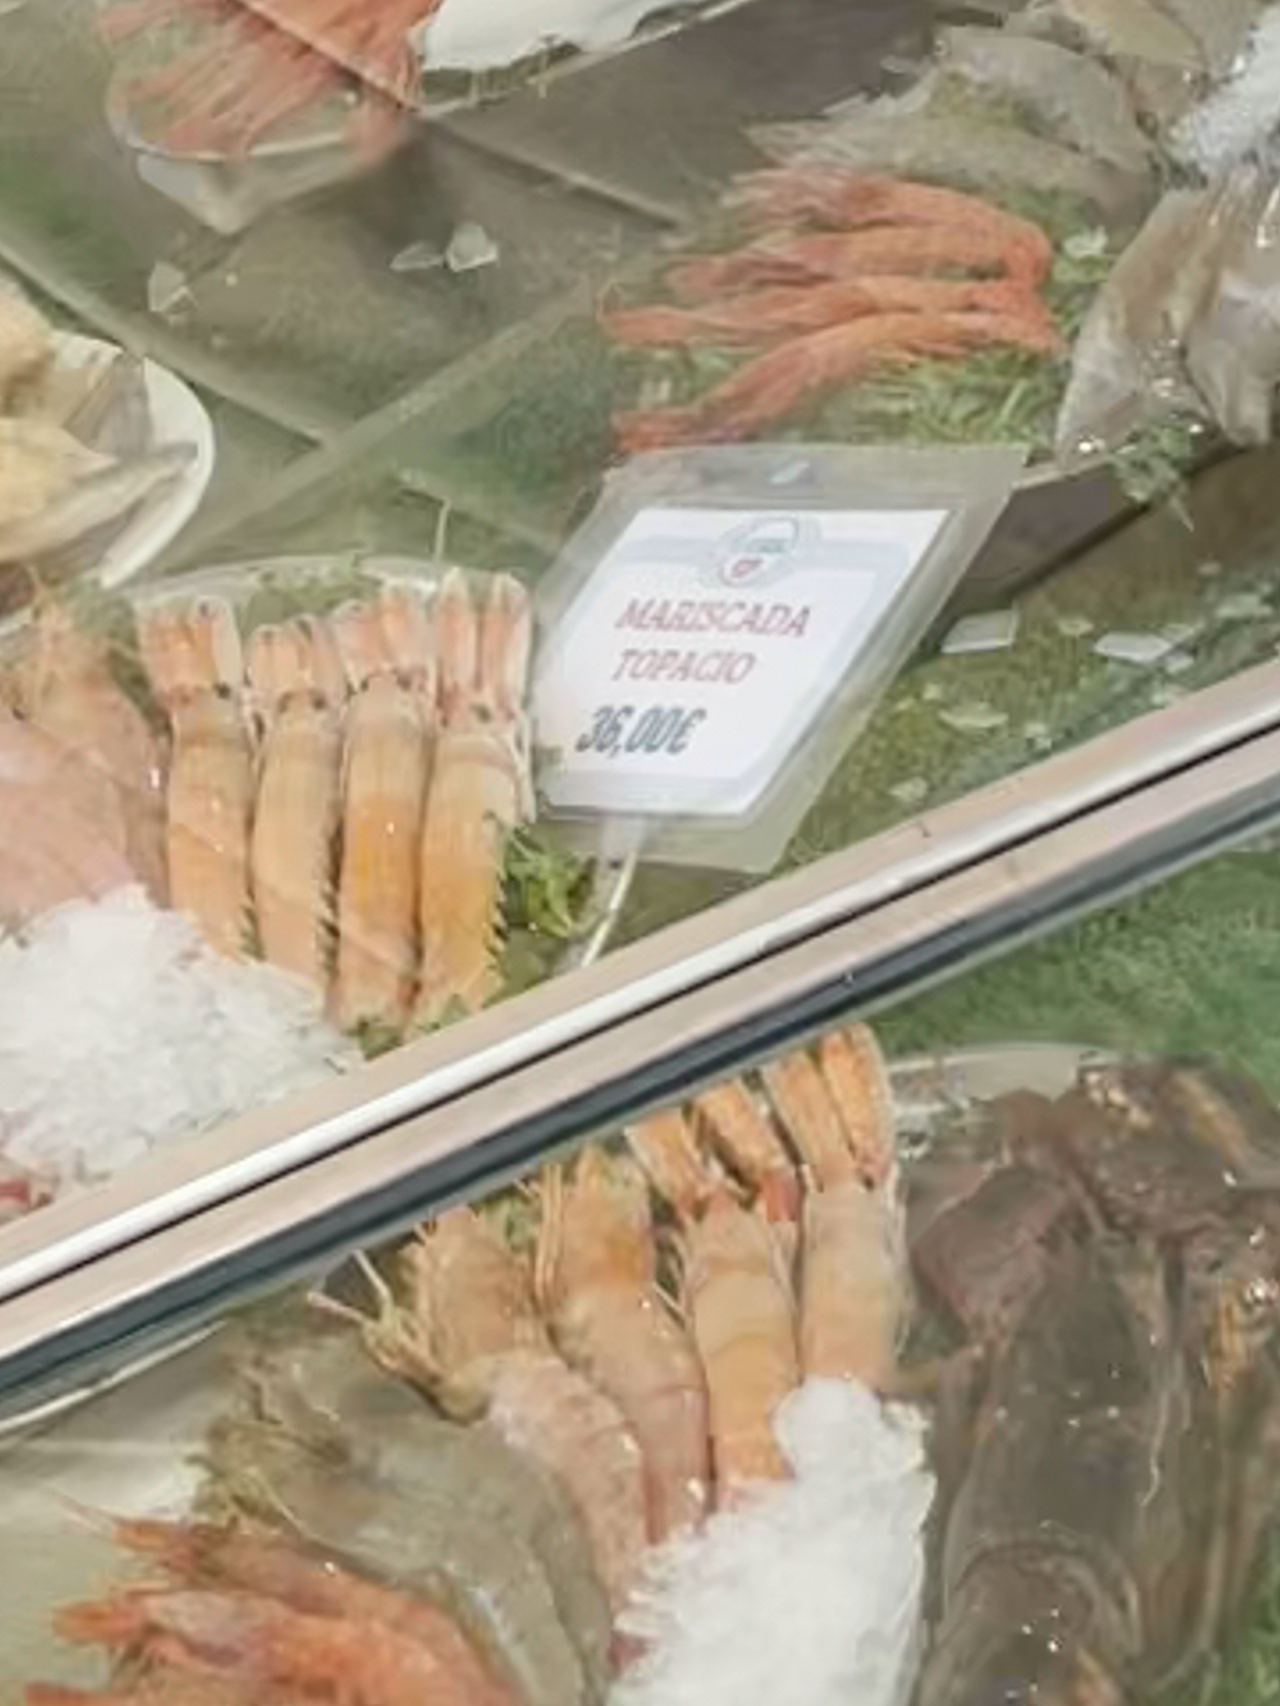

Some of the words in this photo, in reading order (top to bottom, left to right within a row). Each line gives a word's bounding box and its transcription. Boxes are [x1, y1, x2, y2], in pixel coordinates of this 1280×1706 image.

[616, 598, 812, 638] MARISCADA
[612, 648, 757, 685] TOPACIO
[575, 704, 708, 758] 36,00€
